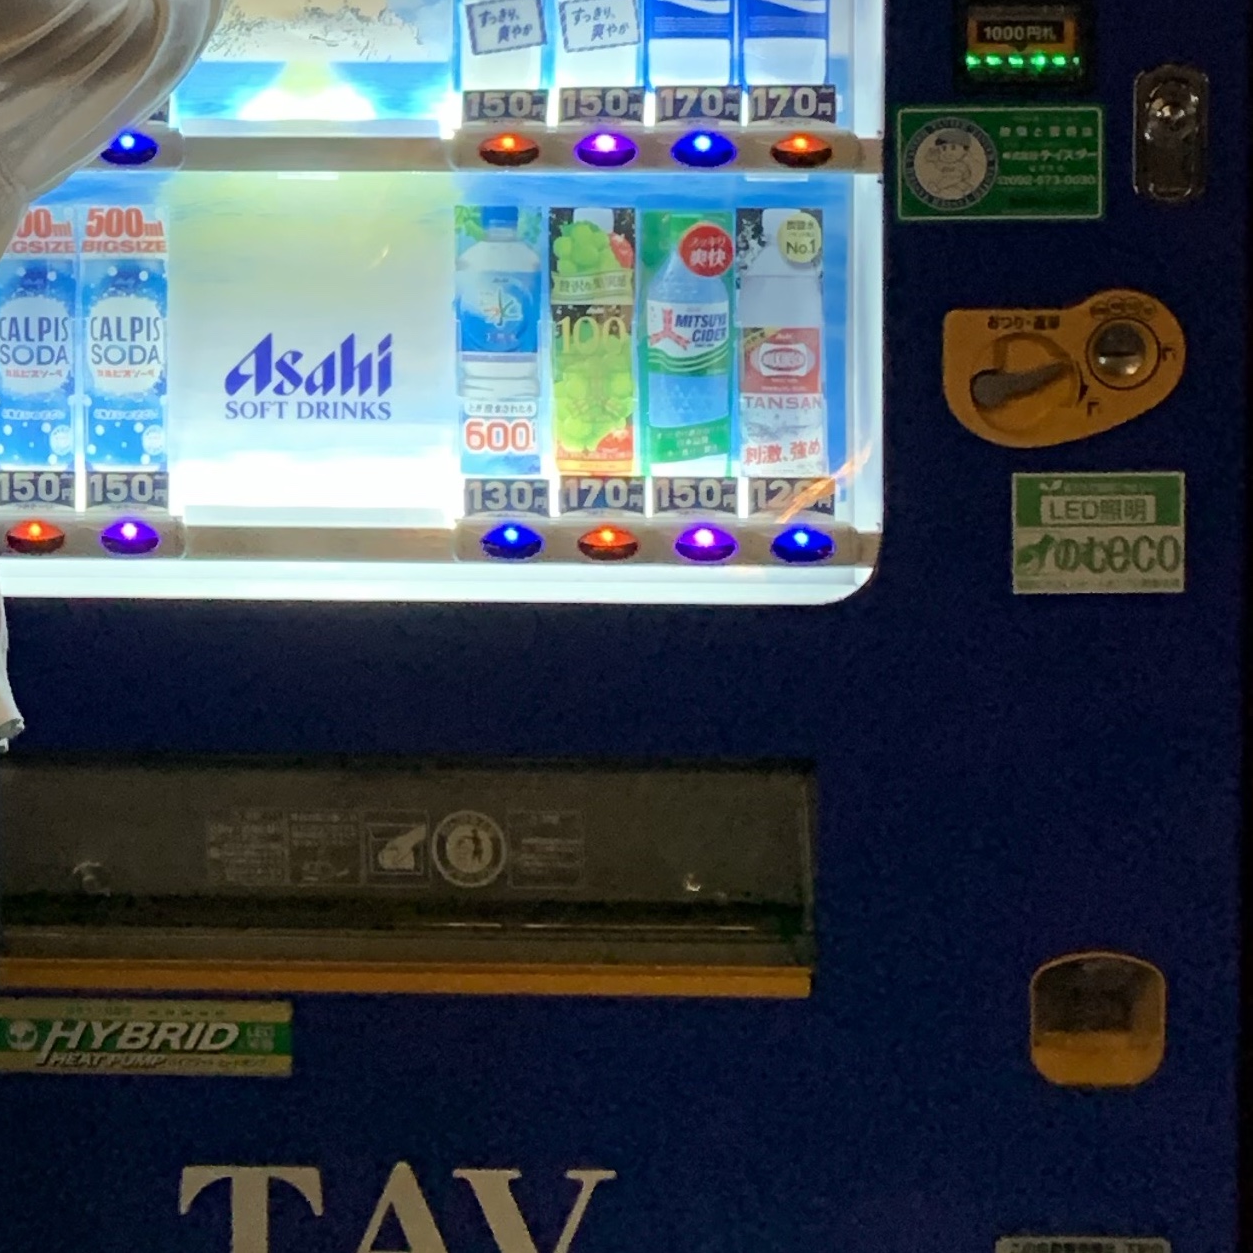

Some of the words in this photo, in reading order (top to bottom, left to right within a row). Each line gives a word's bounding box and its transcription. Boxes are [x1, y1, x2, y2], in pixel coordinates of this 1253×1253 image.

[497, 23, 533, 44] 爽やか
[591, 22, 630, 42] 爽やか
[86, 207, 164, 238] 500ml
[689, 249, 726, 267] 爽快
[786, 240, 816, 254] No.1
[0, 316, 69, 343] CALPIS
[90, 316, 161, 343] CALPIS
[0, 344, 70, 366] SODA
[91, 344, 162, 366] SODA
[224, 332, 394, 397] Asahi
[225, 400, 288, 420] SOFT
[296, 400, 392, 421] DRINKS
[746, 395, 822, 410] TANSAN
[465, 421, 532, 452] 600
[745, 441, 821, 466] 刺激、強め
[1049, 498, 1146, 522] LED照明
[36, 1020, 240, 1067] HYBRID
[50, 1051, 106, 1067] HEAT
[107, 1052, 166, 1066] PUMP
[179, 1161, 617, 1253] TAV
